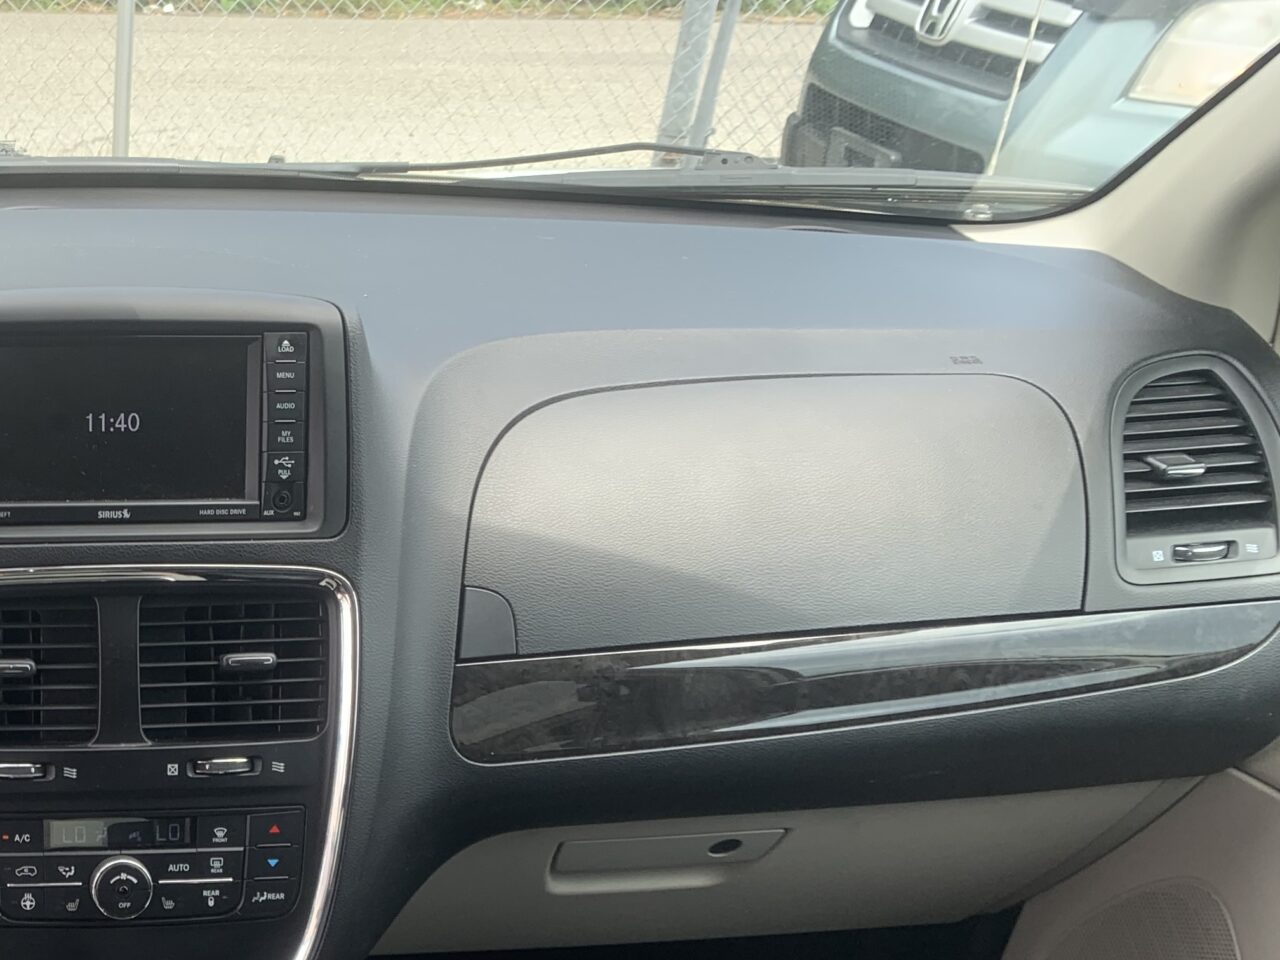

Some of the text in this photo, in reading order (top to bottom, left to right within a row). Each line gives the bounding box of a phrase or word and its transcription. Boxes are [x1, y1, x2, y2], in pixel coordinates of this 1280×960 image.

[85, 412, 140, 432] 11:40
[98, 510, 123, 519] SIRIUS
[14, 834, 31, 843] A/C
[168, 864, 190, 872] AUTO
